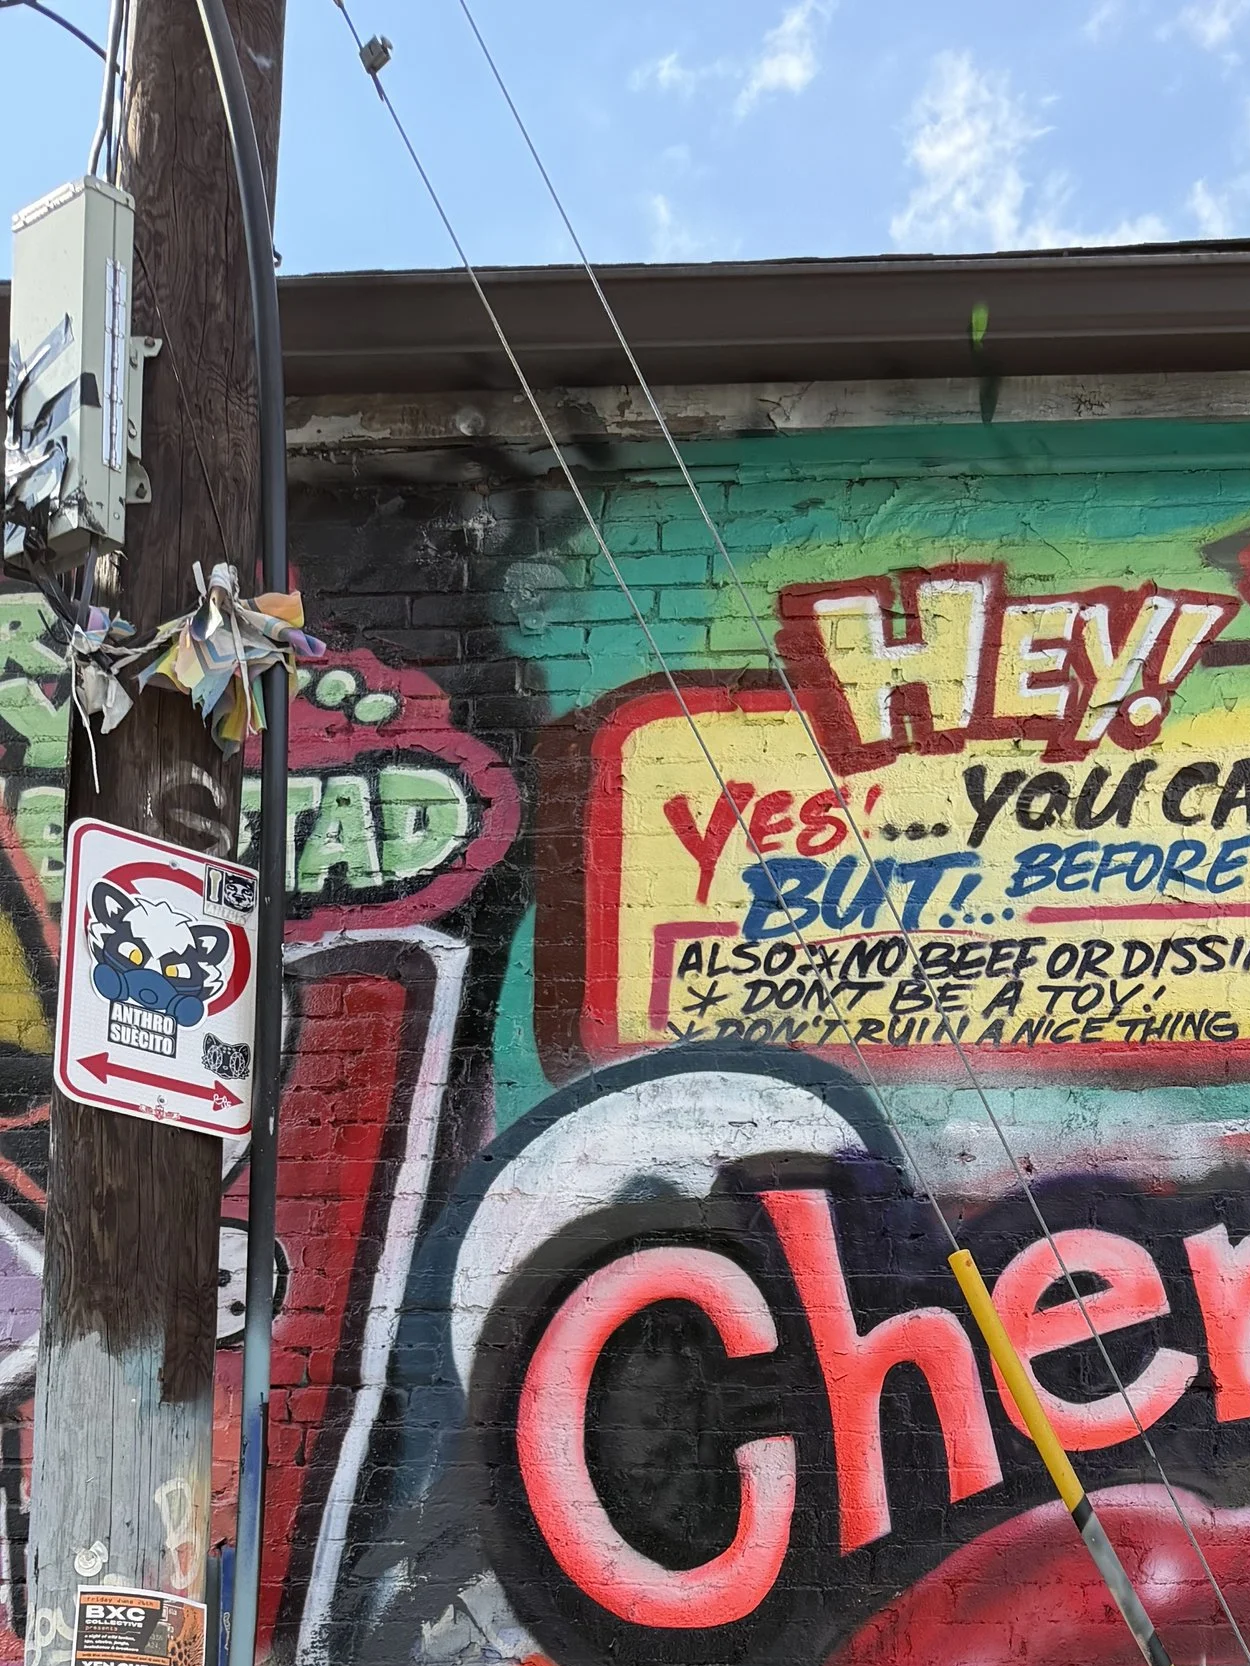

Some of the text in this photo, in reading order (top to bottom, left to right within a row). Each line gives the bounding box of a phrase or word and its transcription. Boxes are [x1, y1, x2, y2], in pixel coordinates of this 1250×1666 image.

[962, 755, 1156, 848] YOU
[911, 937, 1048, 981] BEEF
[1046, 939, 1114, 982] OR
[111, 1001, 176, 1036] ANTHRO
[888, 978, 978, 1016] BE
[982, 979, 1026, 1019] A
[1037, 979, 1167, 1021] TOY!
[855, 1014, 972, 1047] RUIN
[975, 1015, 1012, 1047] A
[1012, 1015, 1111, 1047] NICE
[1116, 1007, 1240, 1045] THING
[85, 1604, 146, 1622] BXC
[85, 1619, 144, 1629] COLLECTIVE
